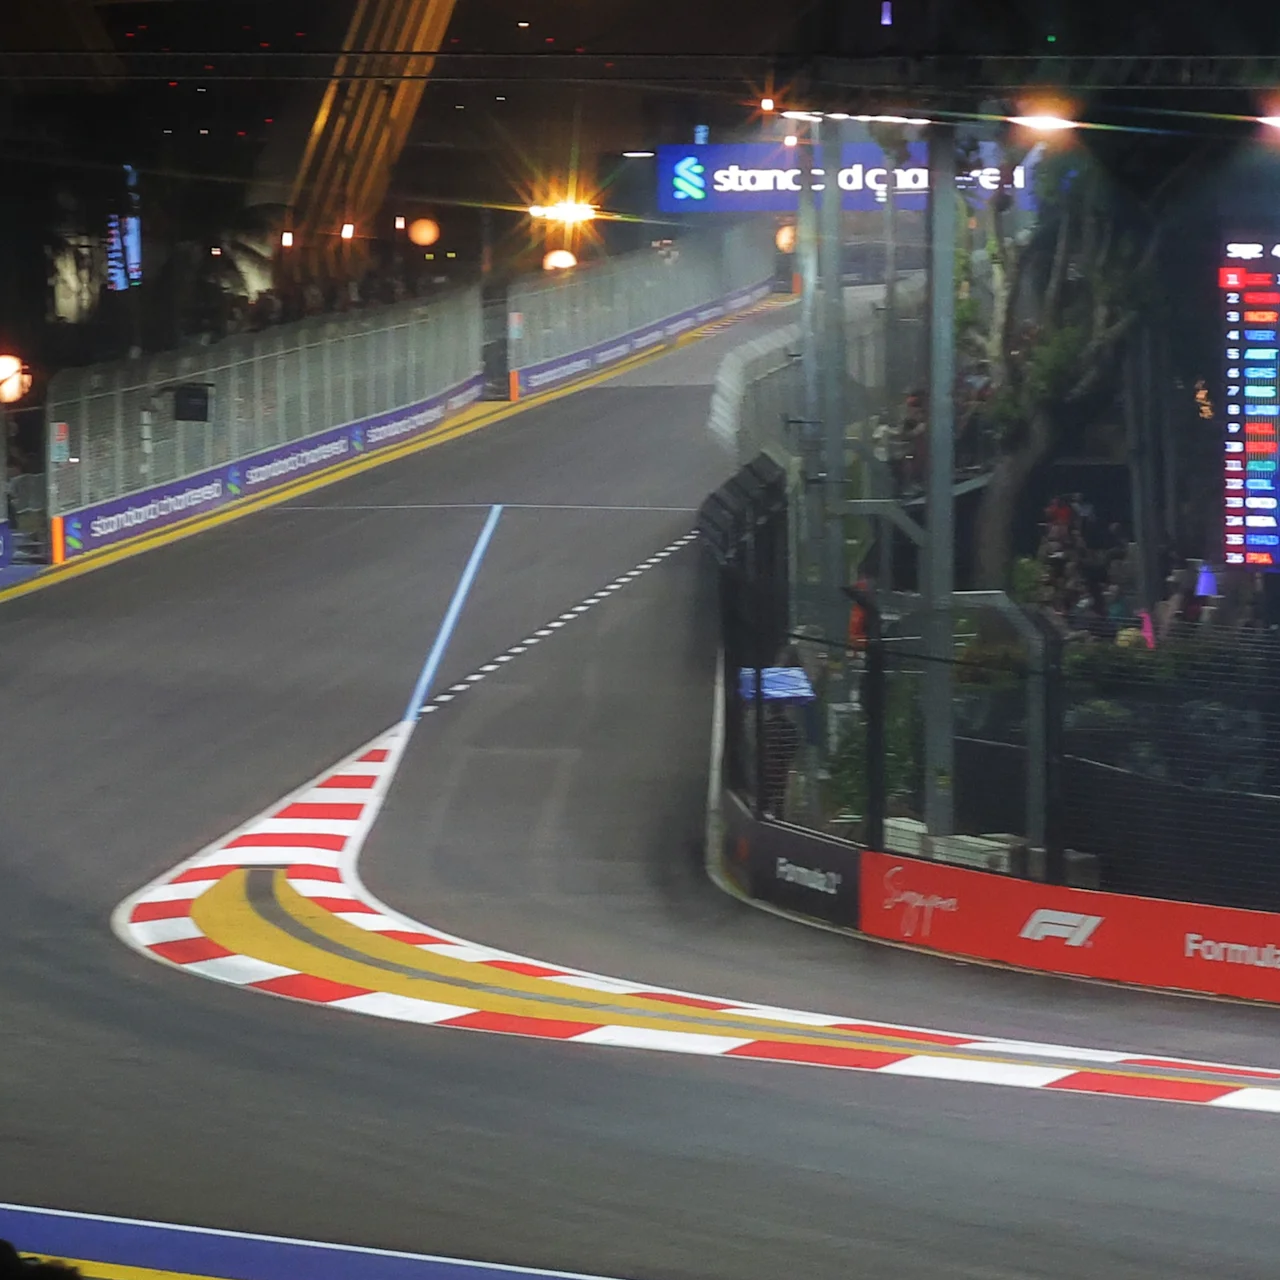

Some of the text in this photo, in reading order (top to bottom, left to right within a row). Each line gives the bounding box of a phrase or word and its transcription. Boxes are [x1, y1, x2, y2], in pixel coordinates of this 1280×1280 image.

[1227, 274, 1240, 285] 1
[1227, 293, 1240, 304] 2
[1227, 312, 1240, 322] 3
[1227, 331, 1240, 340] 4
[1227, 348, 1240, 359] 5
[1227, 368, 1240, 378] 6
[1227, 386, 1240, 396] 7
